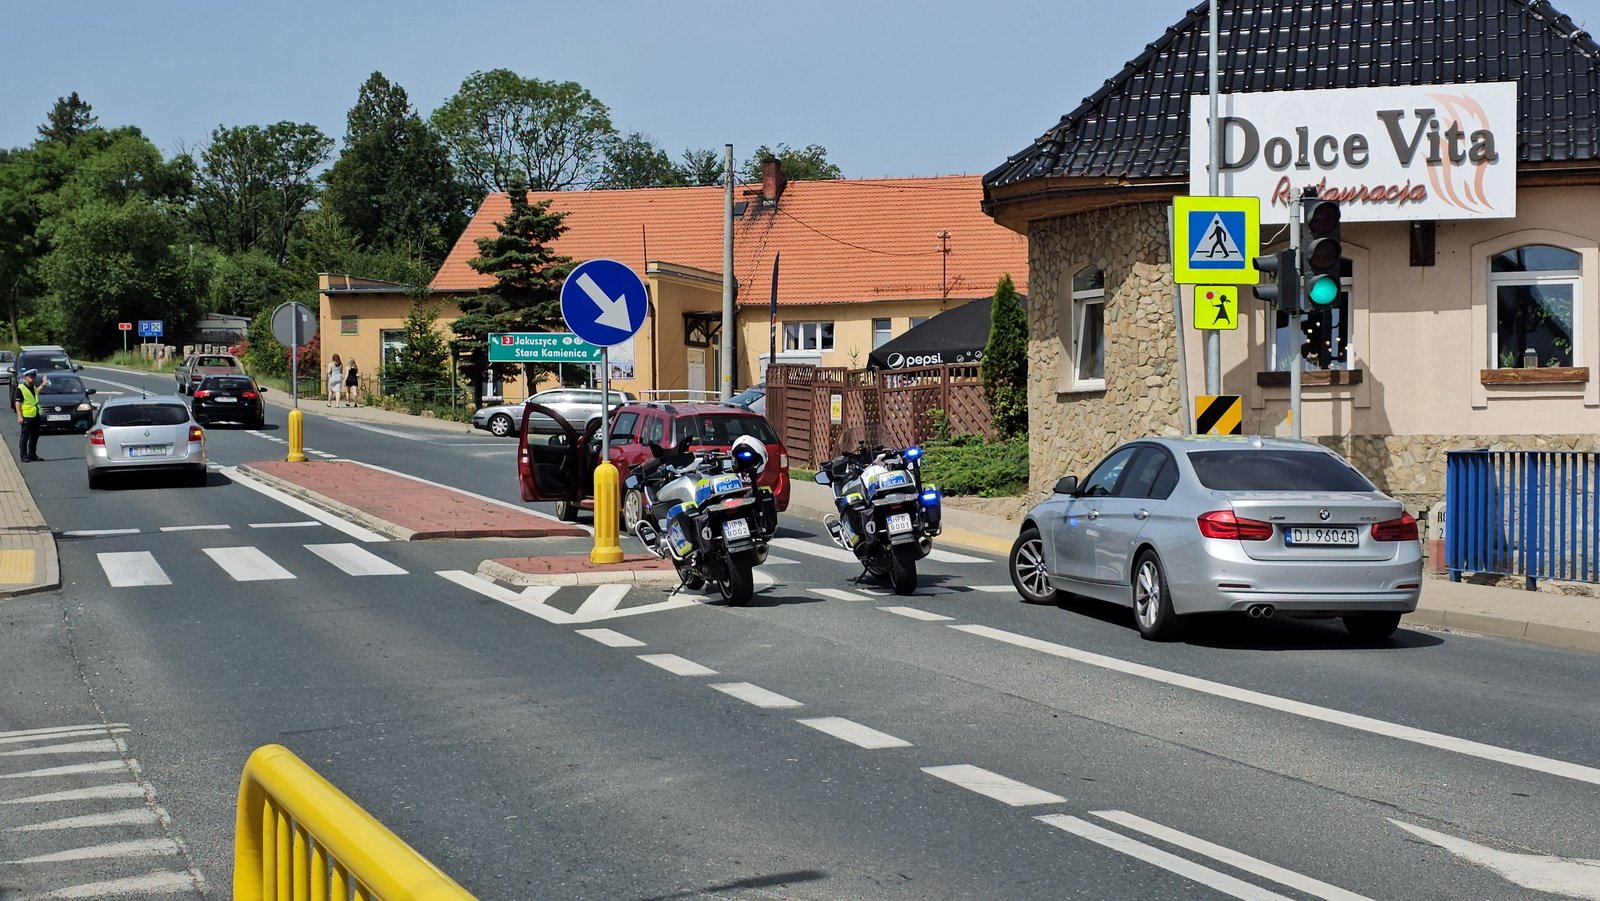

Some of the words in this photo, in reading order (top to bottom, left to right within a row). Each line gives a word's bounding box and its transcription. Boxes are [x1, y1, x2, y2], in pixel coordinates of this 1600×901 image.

[1206, 117, 1369, 169] Dolce
[1377, 109, 1498, 164] Vita
[1271, 175, 1427, 206] Rtauracja
[505, 336, 510, 344] 3
[515, 336, 558, 347] Jakuszyce
[515, 348, 538, 357] Stara
[541, 348, 587, 357] Kamienica
[906, 353, 941, 367] pepsi
[719, 483, 740, 492] POLICJA
[1294, 529, 1310, 541] DJ
[1315, 529, 1355, 543] 96043
